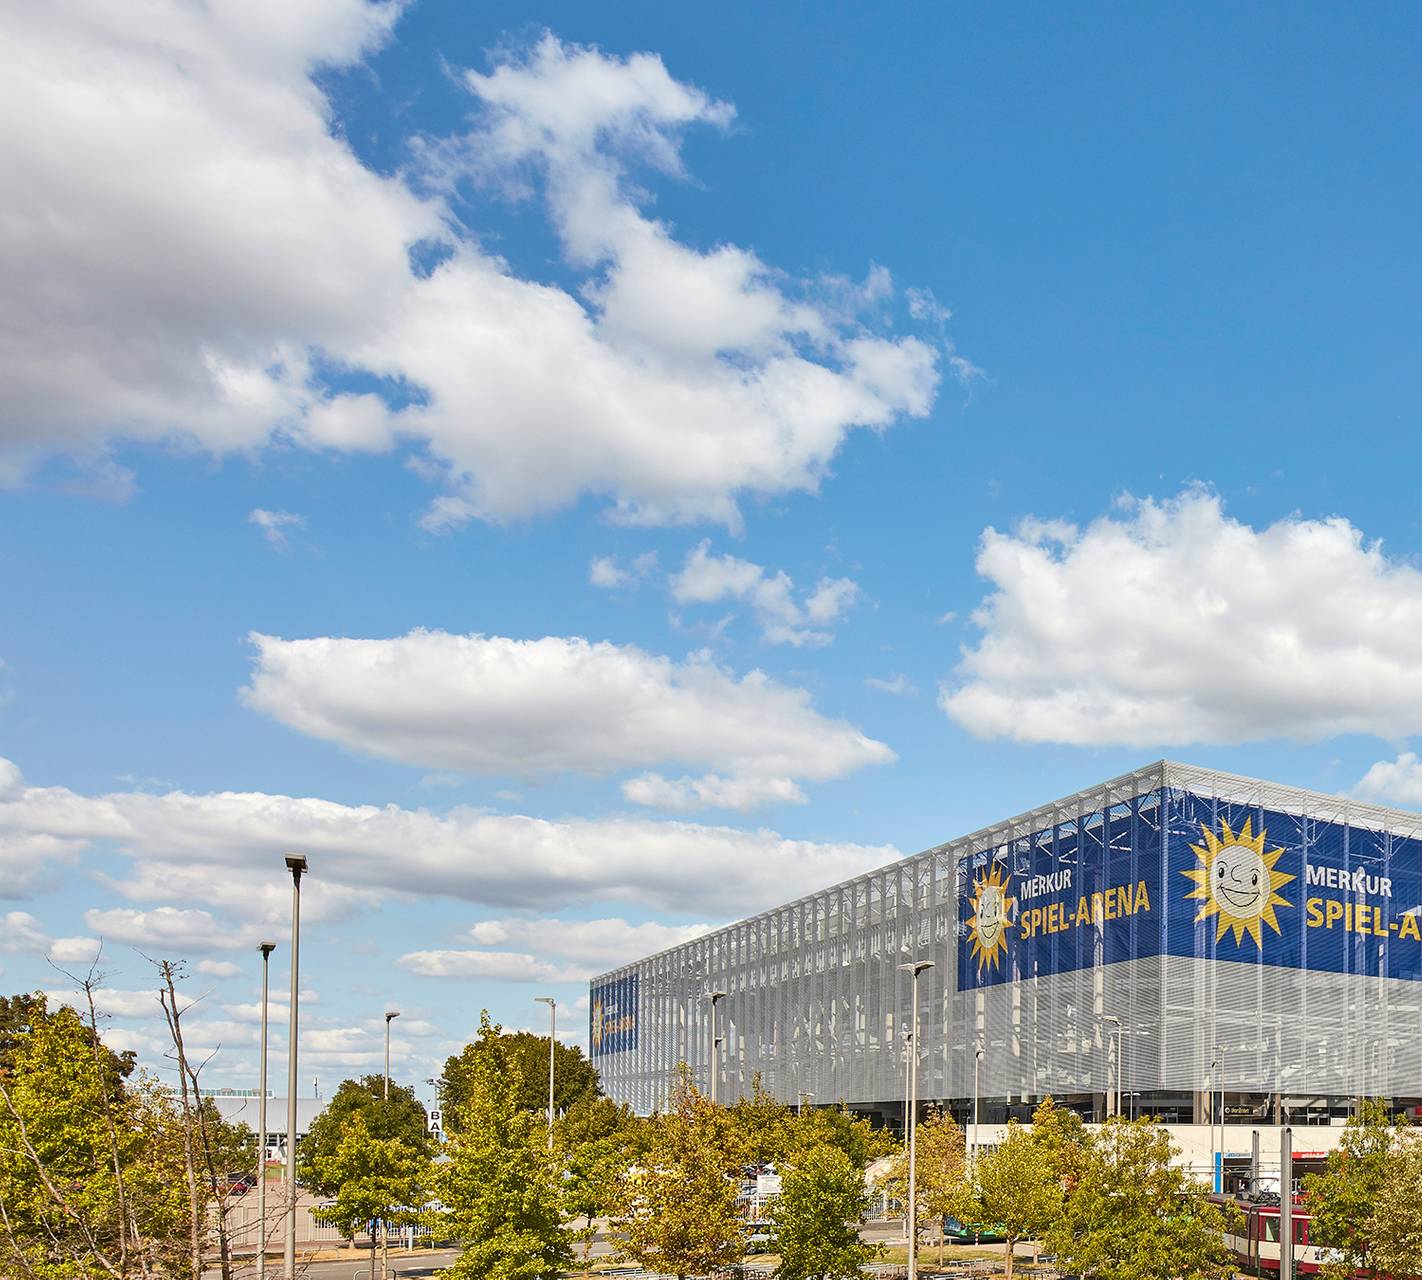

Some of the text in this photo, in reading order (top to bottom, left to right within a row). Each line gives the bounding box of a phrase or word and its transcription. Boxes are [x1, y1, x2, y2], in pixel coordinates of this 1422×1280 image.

[1020, 868, 1072, 901] MERKUR
[1305, 864, 1393, 898] MERKUR
[1020, 880, 1151, 940] SPIEL-ARENA
[430, 1122, 440, 1131] A
[431, 1111, 440, 1120] B
